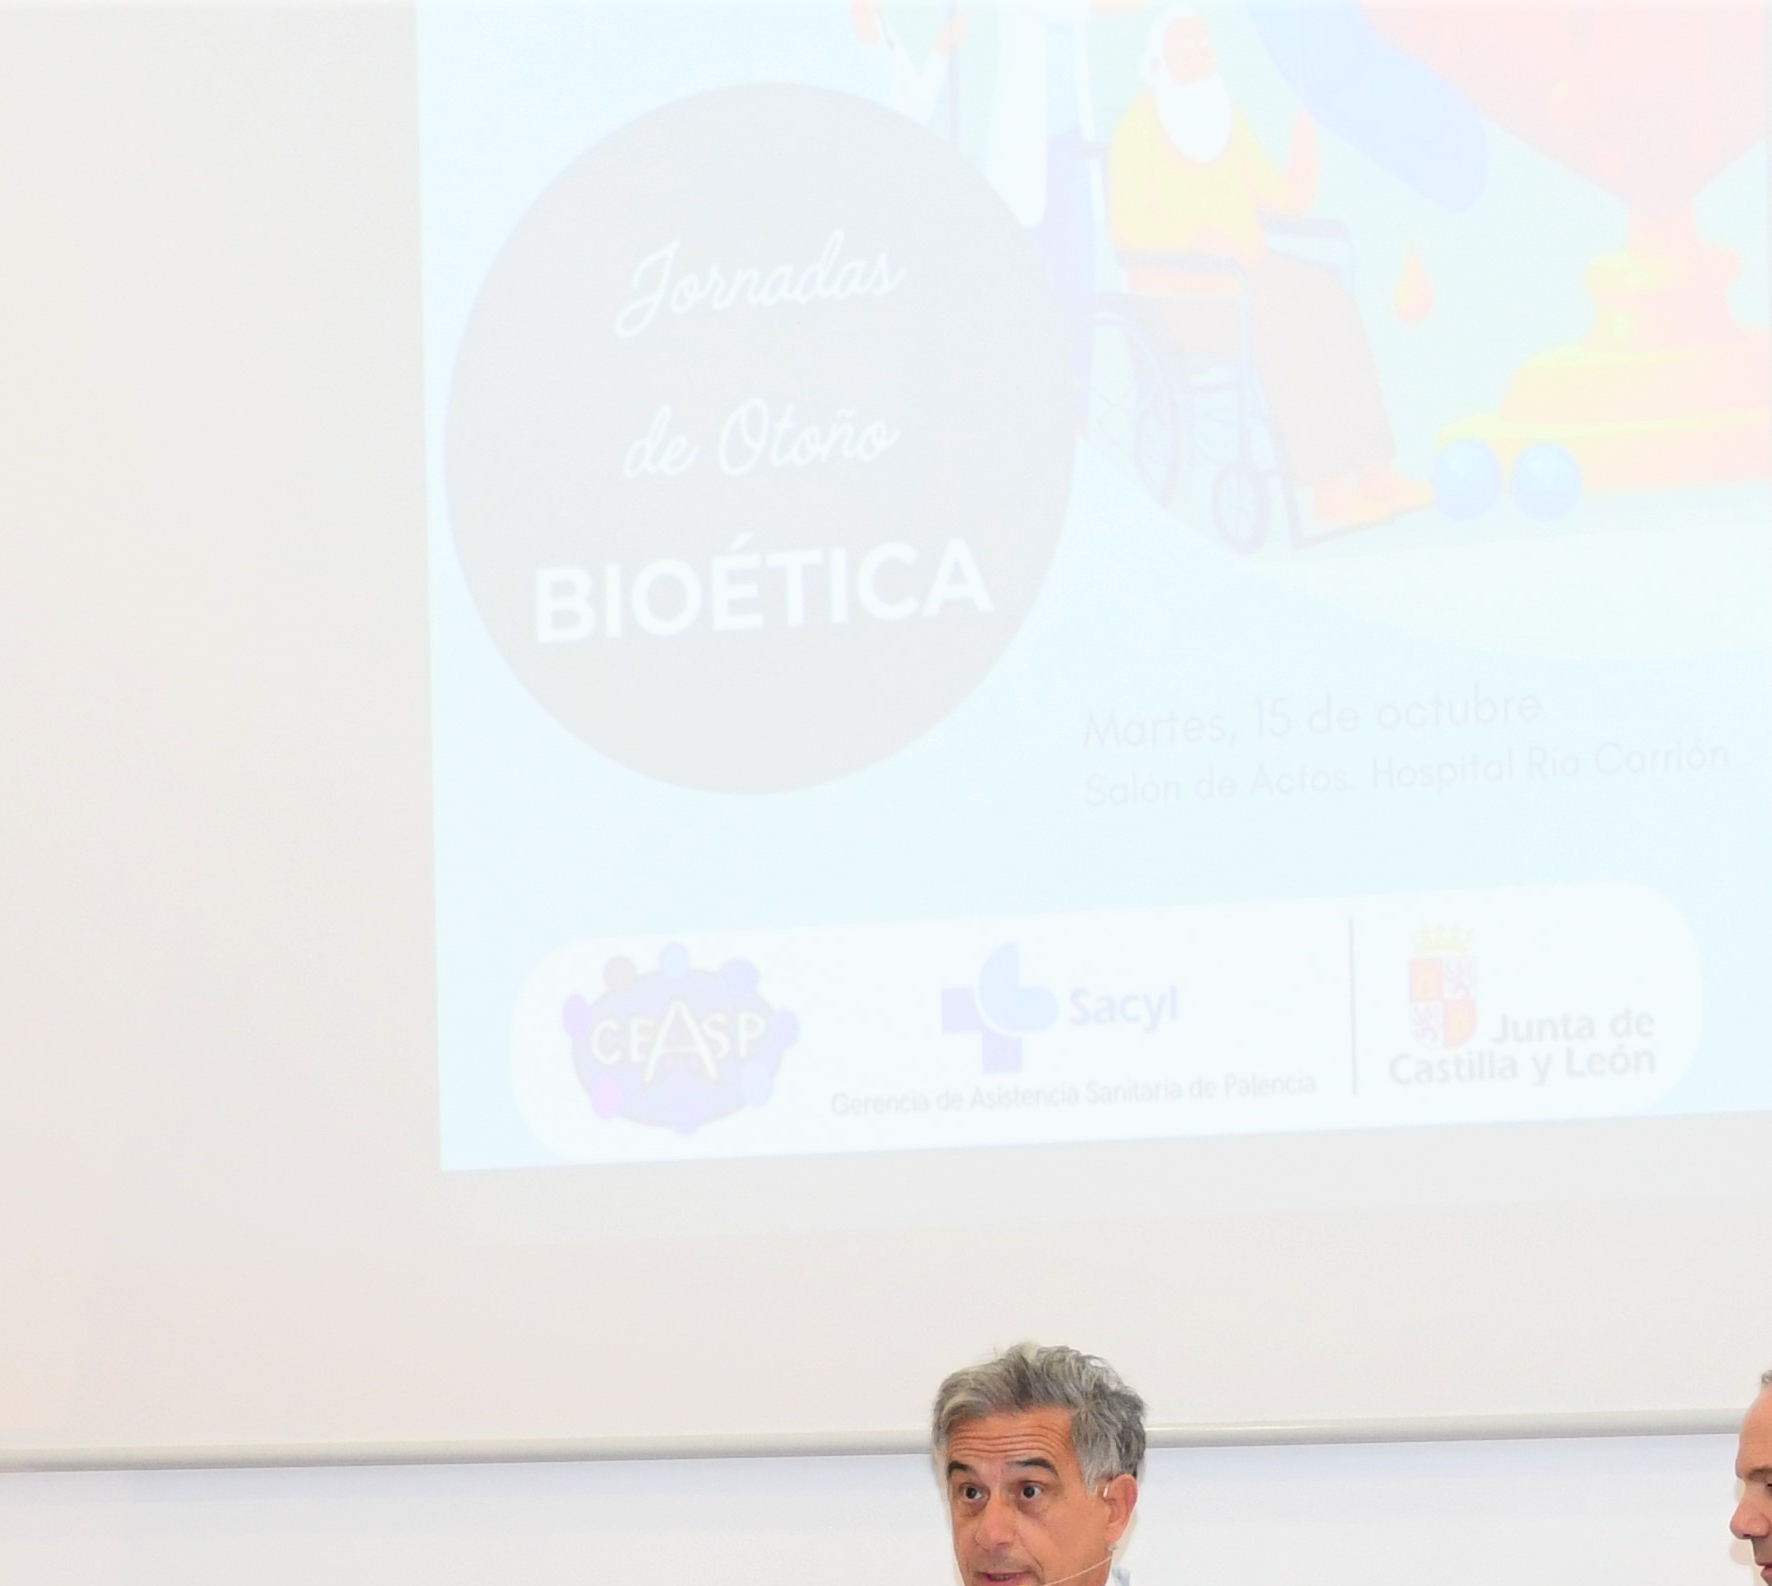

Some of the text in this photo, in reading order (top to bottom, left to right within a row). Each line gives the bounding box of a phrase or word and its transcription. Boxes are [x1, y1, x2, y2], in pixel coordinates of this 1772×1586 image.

[615, 228, 906, 338] Jornadas
[623, 397, 900, 478] de Otoño
[534, 532, 994, 644] BIOÉTICA
[1083, 681, 1543, 751] Martes, 15 de octubre
[1085, 771, 1181, 808] Salón
[1193, 763, 1238, 801] de
[1371, 745, 1515, 796] Hospital
[1527, 742, 1581, 781] Río
[1594, 734, 1730, 776] Carrión
[1068, 983, 1180, 1035] Sacyl
[1493, 1005, 1656, 1044] Junta de
[831, 1071, 1317, 1117] Gerencia de Asistencia Sanitaria de Palencia
[1388, 1043, 1657, 1088] Castilla y León
